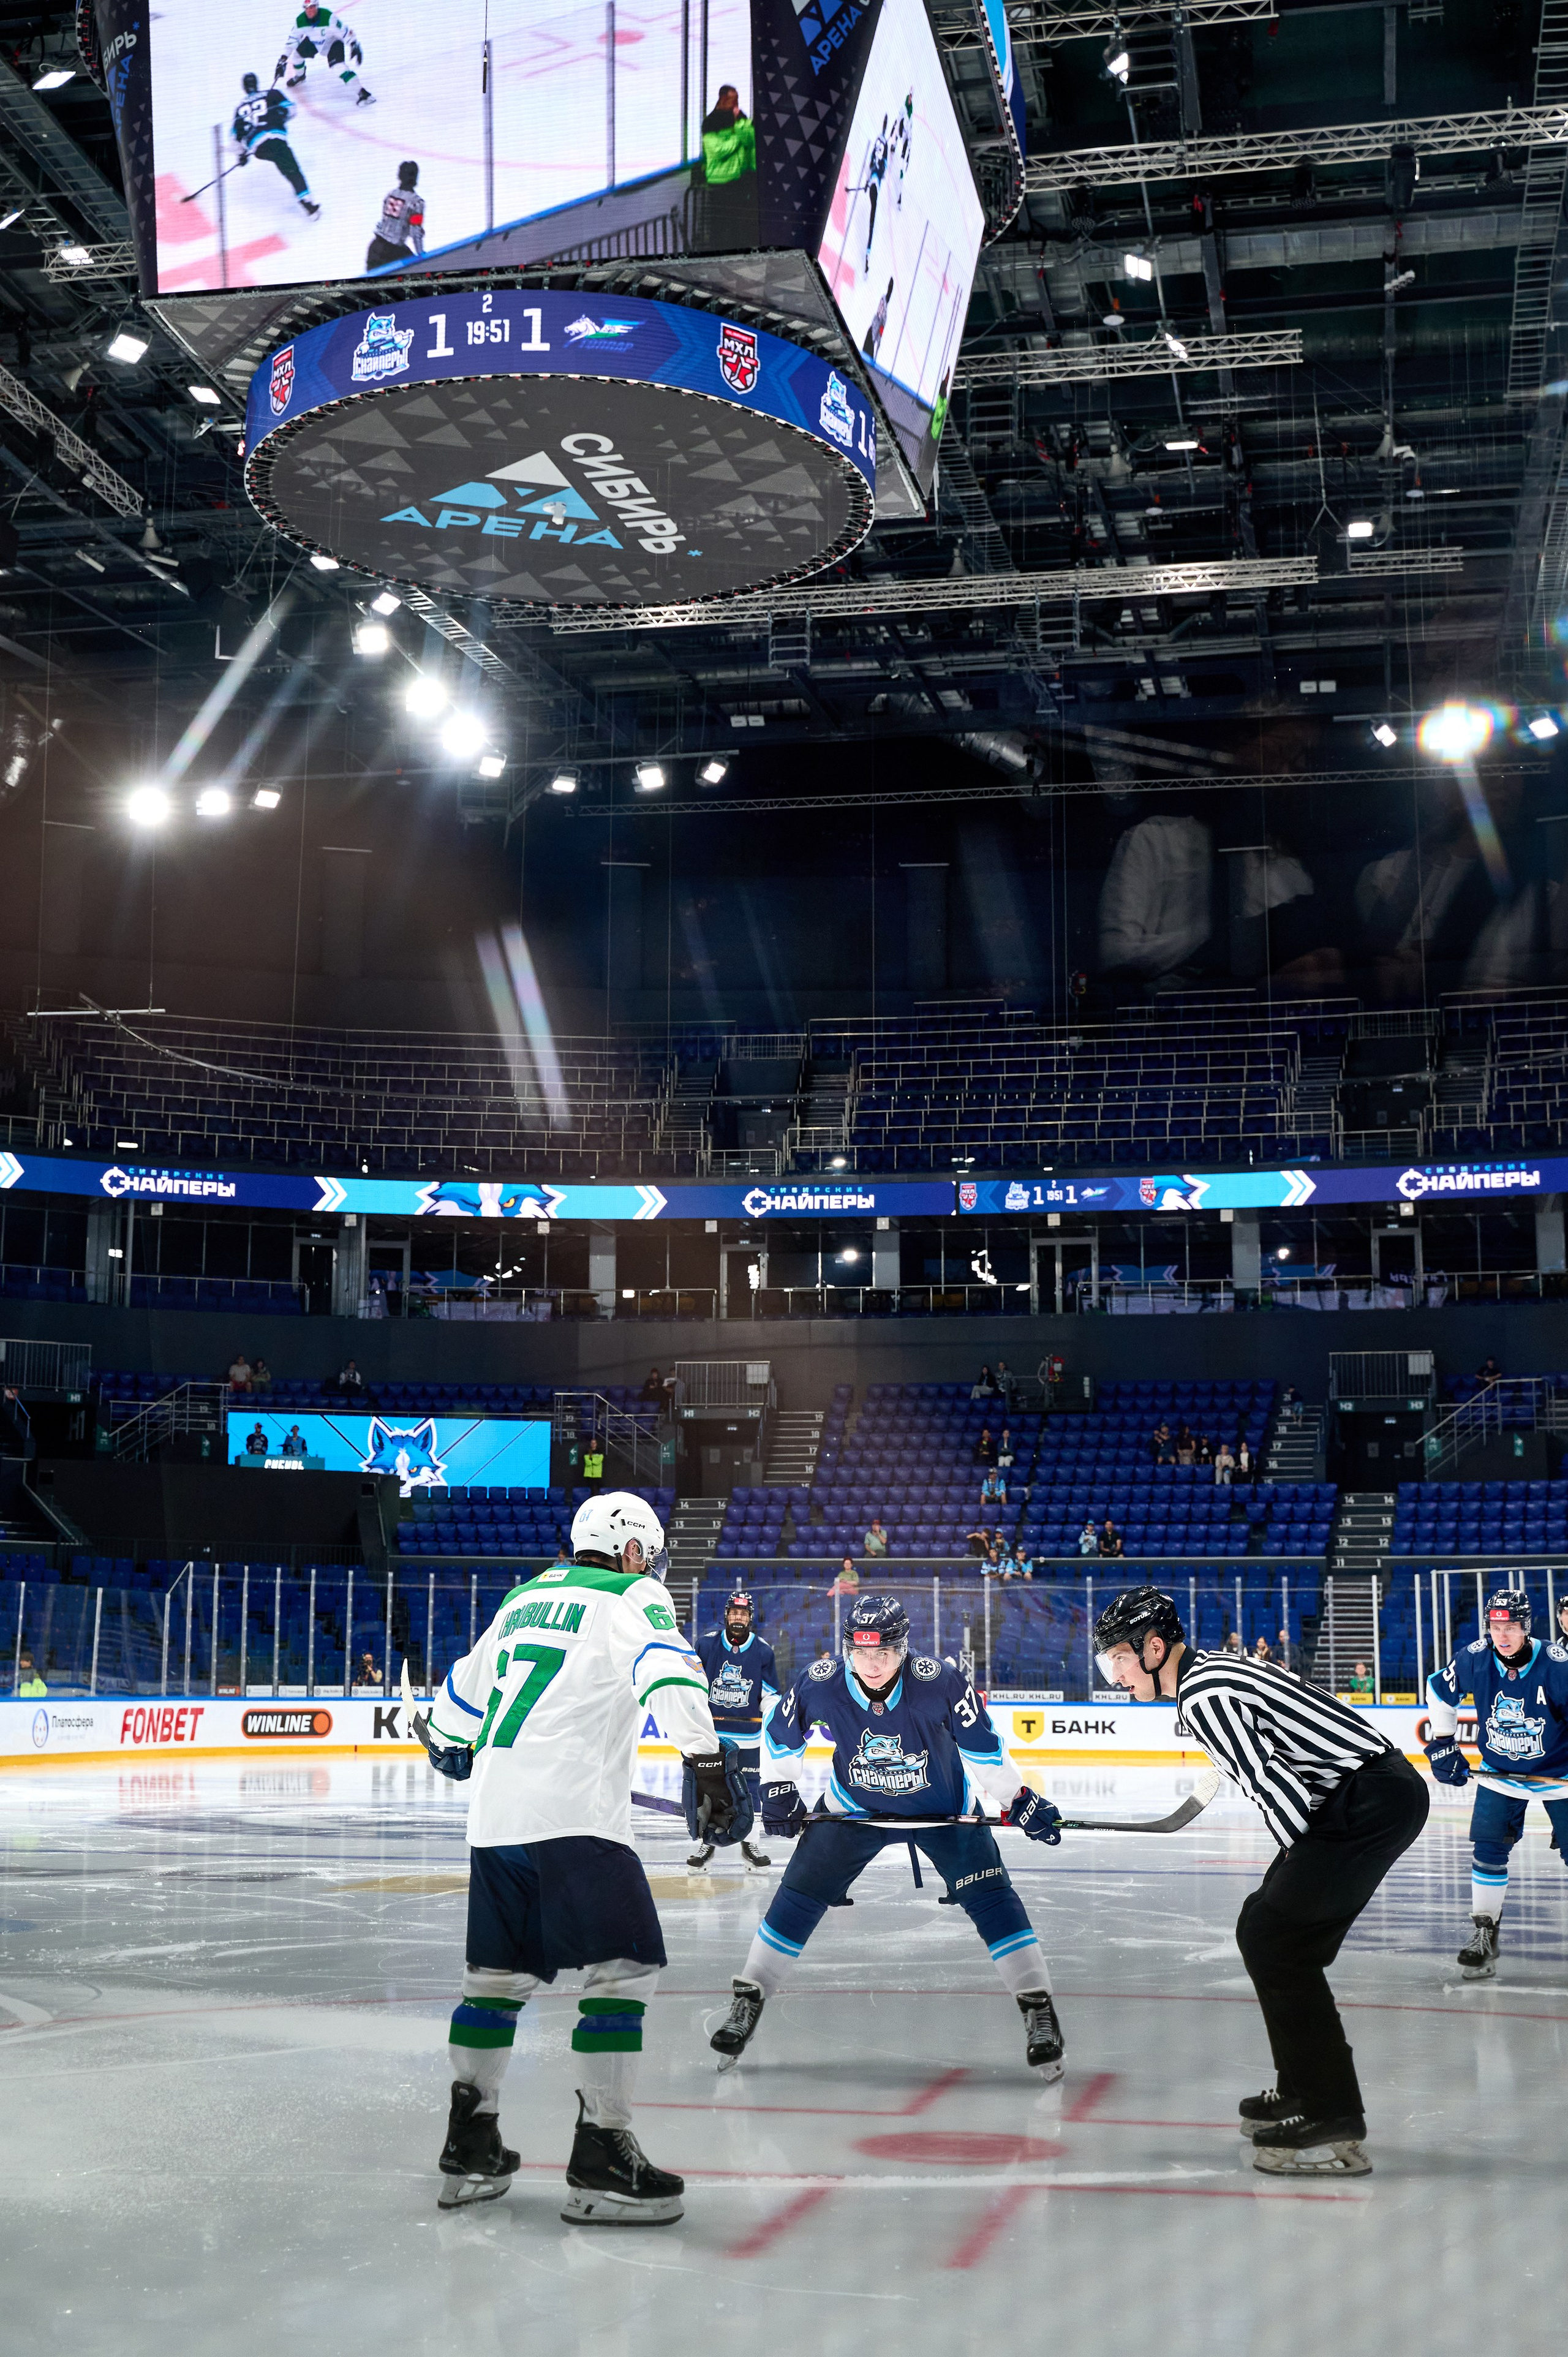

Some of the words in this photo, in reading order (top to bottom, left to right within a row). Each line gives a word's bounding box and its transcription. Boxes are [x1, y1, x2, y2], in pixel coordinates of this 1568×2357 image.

[810, 6, 863, 76] АРЕНА
[104, 31, 137, 70] БИРЬ
[482, 293, 492, 313] 2
[427, 314, 454, 358] 1
[467, 319, 510, 345] 19:51
[521, 308, 550, 351] 1
[724, 338, 753, 358] МХЛ
[273, 361, 292, 378] МХЛ
[560, 432, 687, 554] СИБИРЬ
[379, 505, 624, 549] АРЕНА
[129, 1167, 224, 1180] СИБИРСКИЕ
[1425, 1163, 1526, 1174] СИБИРСКИЕ
[100, 1166, 235, 1197] СНАЙПЕРЫ
[1052, 1180, 1057, 1189] 2
[1396, 1167, 1540, 1201] СНАЙПЕРЫ
[742, 1188, 874, 1218] СНАЙПЕРЫ
[1033, 1186, 1044, 1204] 1
[1066, 1185, 1078, 1204] 1
[809, 1447, 818, 1455] 17
[805, 1465, 813, 1474] 16
[718, 1501, 726, 1509] 14
[579, 1509, 594, 1523] 67
[627, 1520, 646, 1529] CCM
[712, 1520, 722, 1529] 13
[1342, 1517, 1352, 1526] 13
[1382, 1517, 1392, 1526] 13
[707, 1540, 716, 1548] 12
[1338, 1538, 1348, 1547] 12
[1379, 1538, 1389, 1547] 12
[1336, 1558, 1344, 1567] 11
[643, 1604, 676, 1630] 6
[861, 1613, 876, 1624] 37
[1536, 1686, 1547, 1705] A
[954, 1684, 979, 1728] 37
[120, 1706, 205, 1744] FONBET
[247, 1713, 312, 1733] WINLINE
[1052, 1720, 1117, 1734] БАНК
[1431, 1743, 1460, 1761] BAUE
[768, 1783, 798, 1798] BAU
[1019, 1793, 1039, 1826] BAU
[956, 1867, 1003, 1890] BAUER
